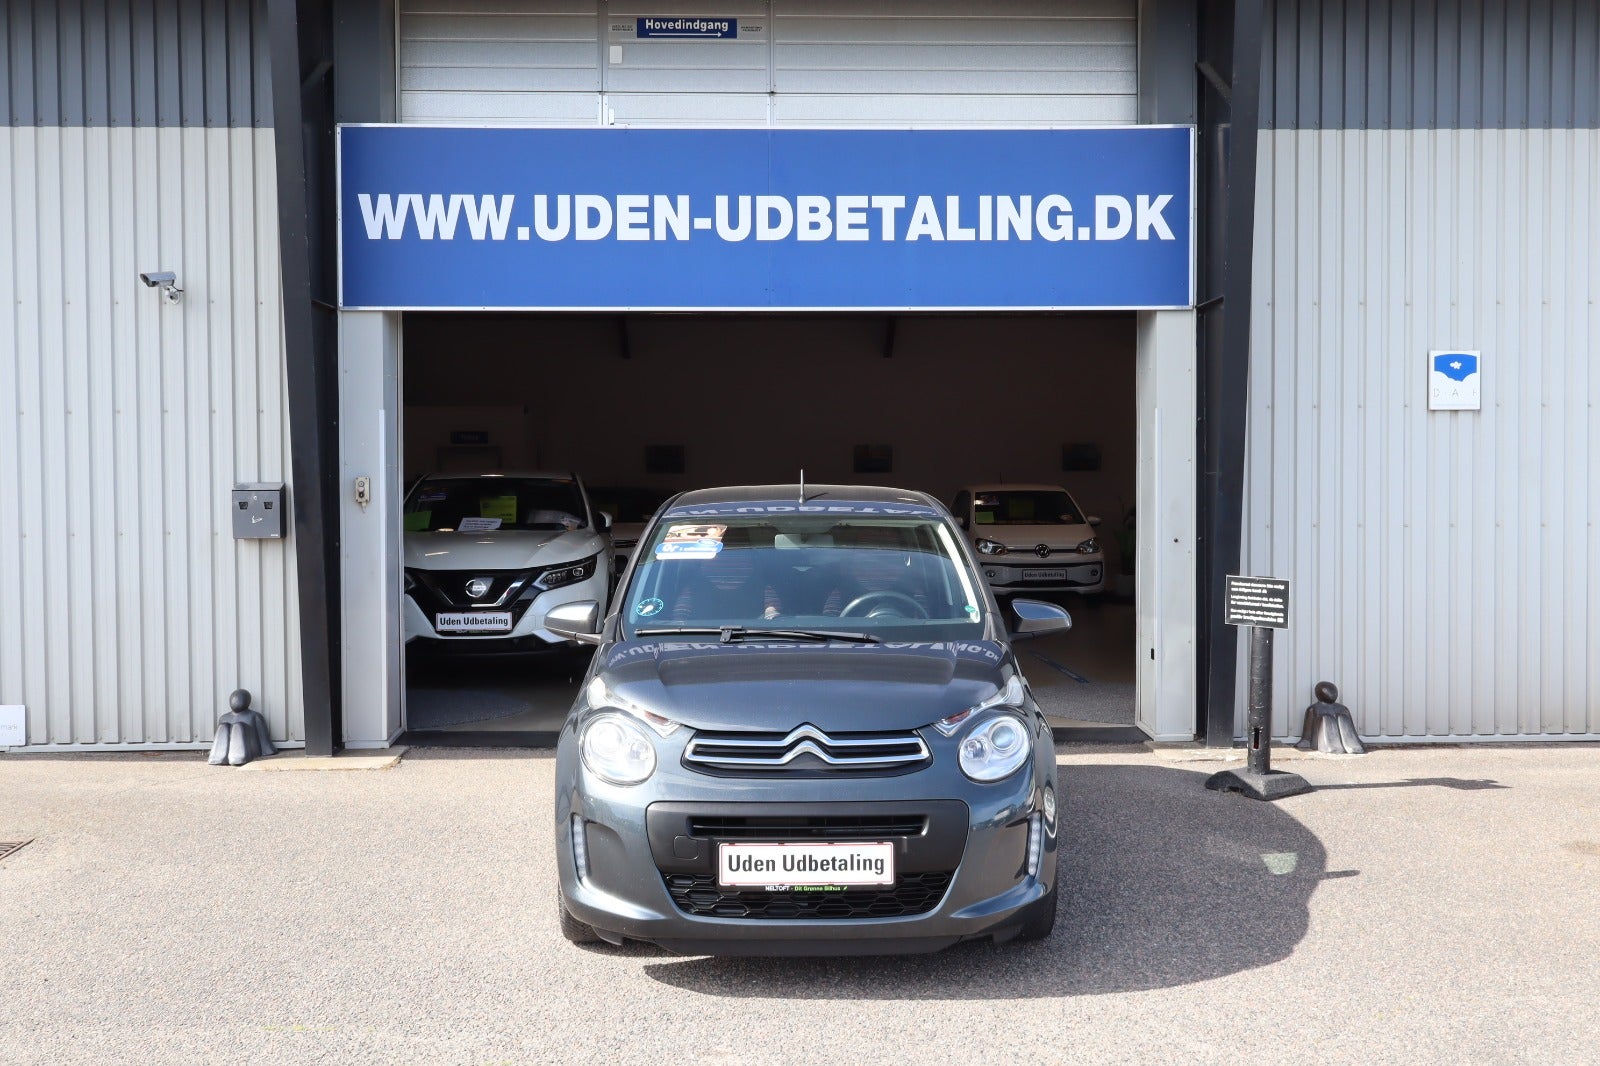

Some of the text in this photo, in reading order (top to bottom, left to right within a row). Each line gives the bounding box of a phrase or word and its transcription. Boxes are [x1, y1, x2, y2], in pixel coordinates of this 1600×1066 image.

[645, 18, 729, 32] Hovedindgang
[357, 193, 1177, 242] WWW.UDEN-UDBETALING.DK
[439, 616, 508, 627] Uden Udbetaling
[727, 853, 885, 875] Uden Udbetaling
